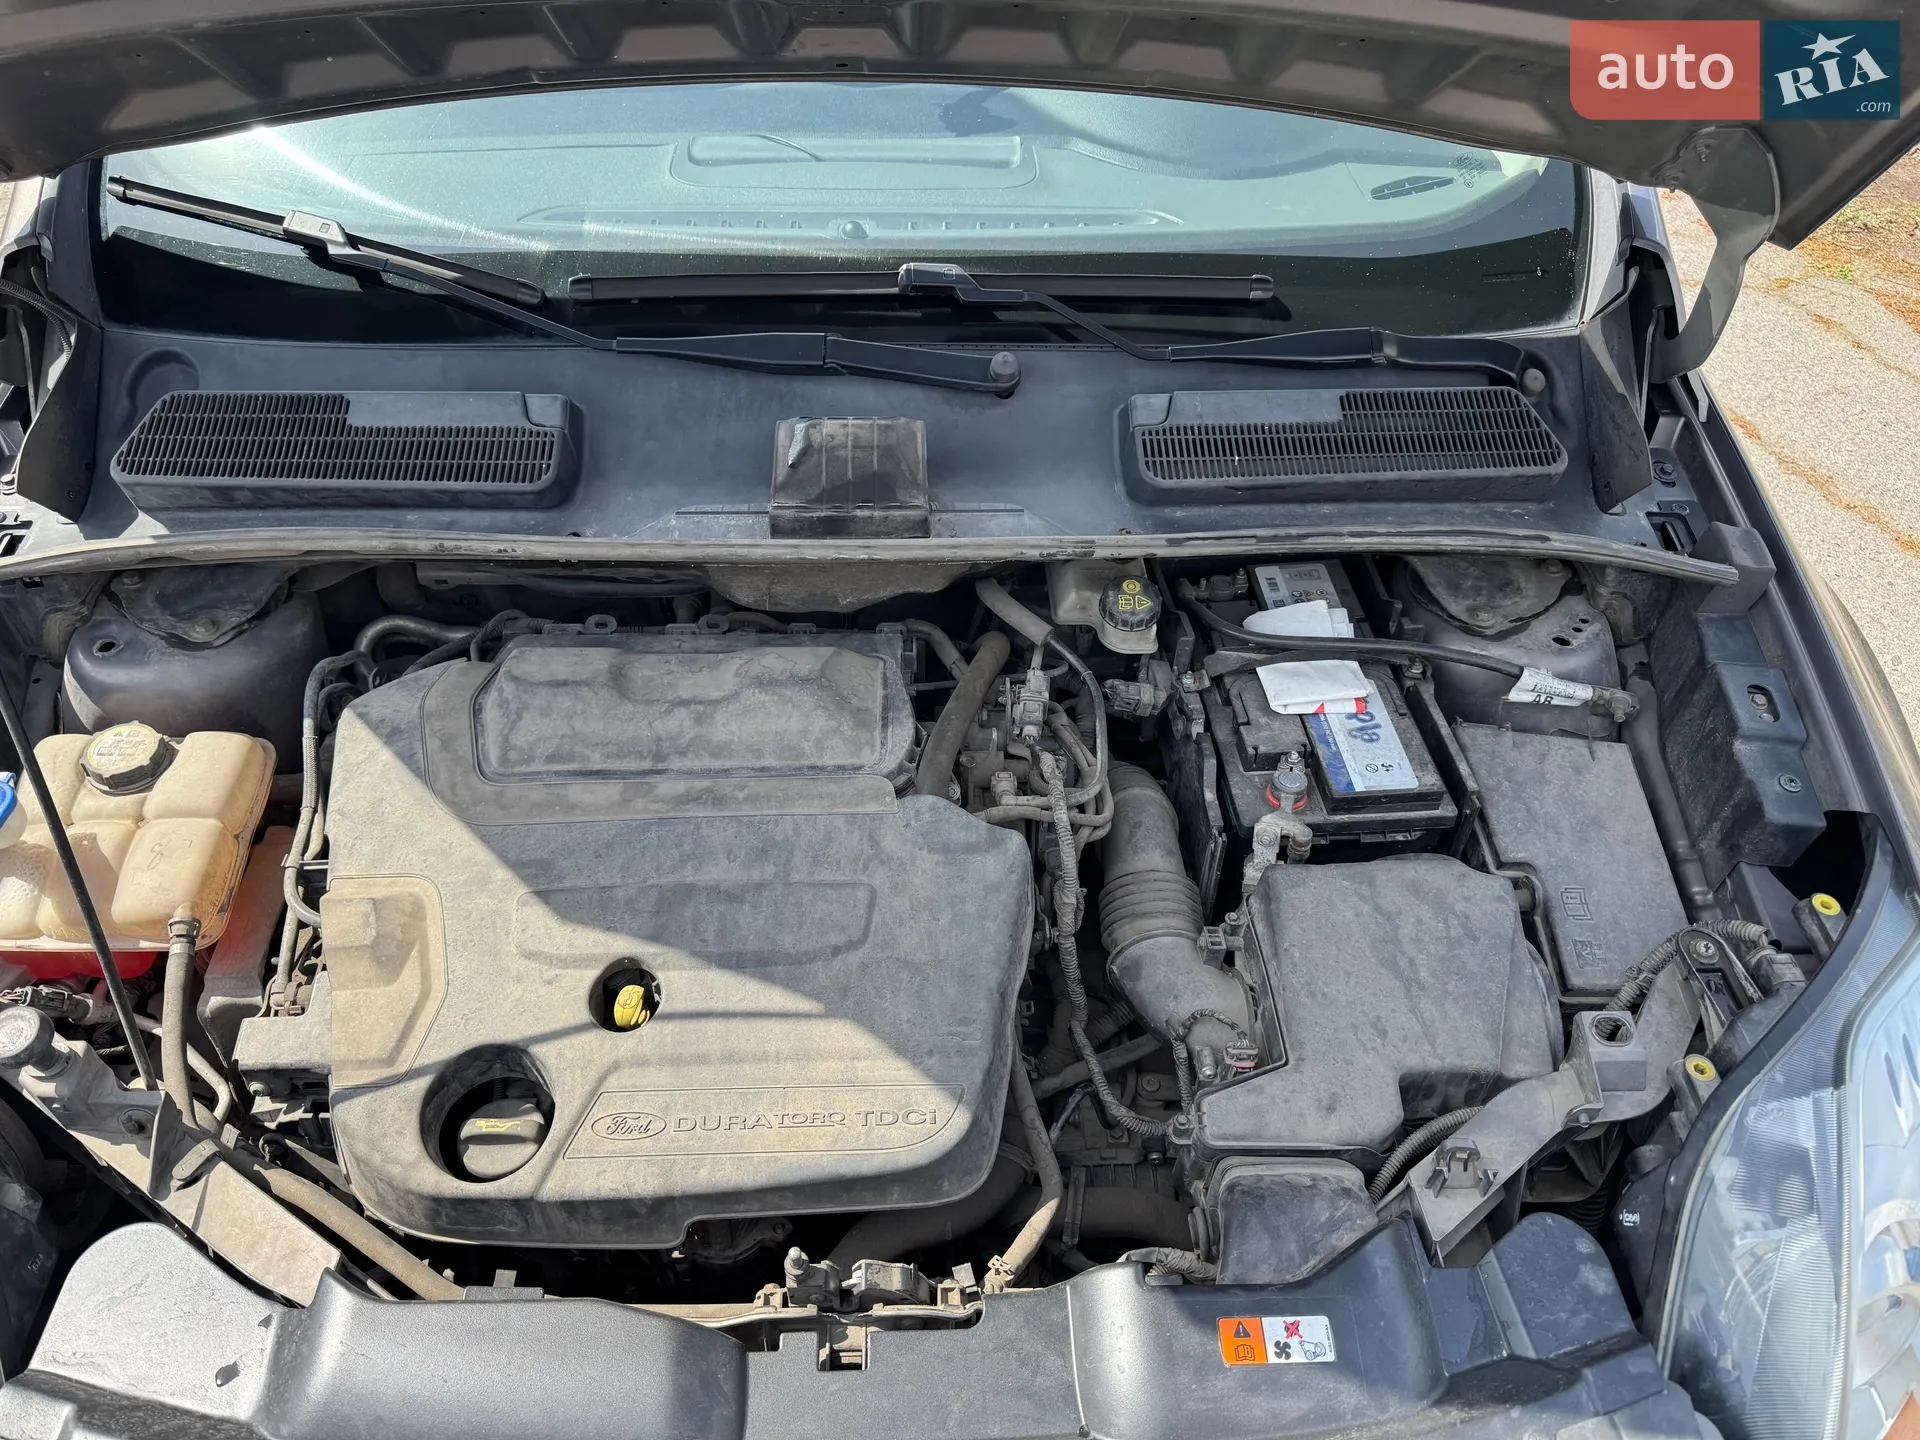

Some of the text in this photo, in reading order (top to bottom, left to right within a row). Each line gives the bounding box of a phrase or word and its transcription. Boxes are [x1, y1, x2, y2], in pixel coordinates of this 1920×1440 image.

[606, 1109, 937, 1135] Ford DURATORQ TDCi
